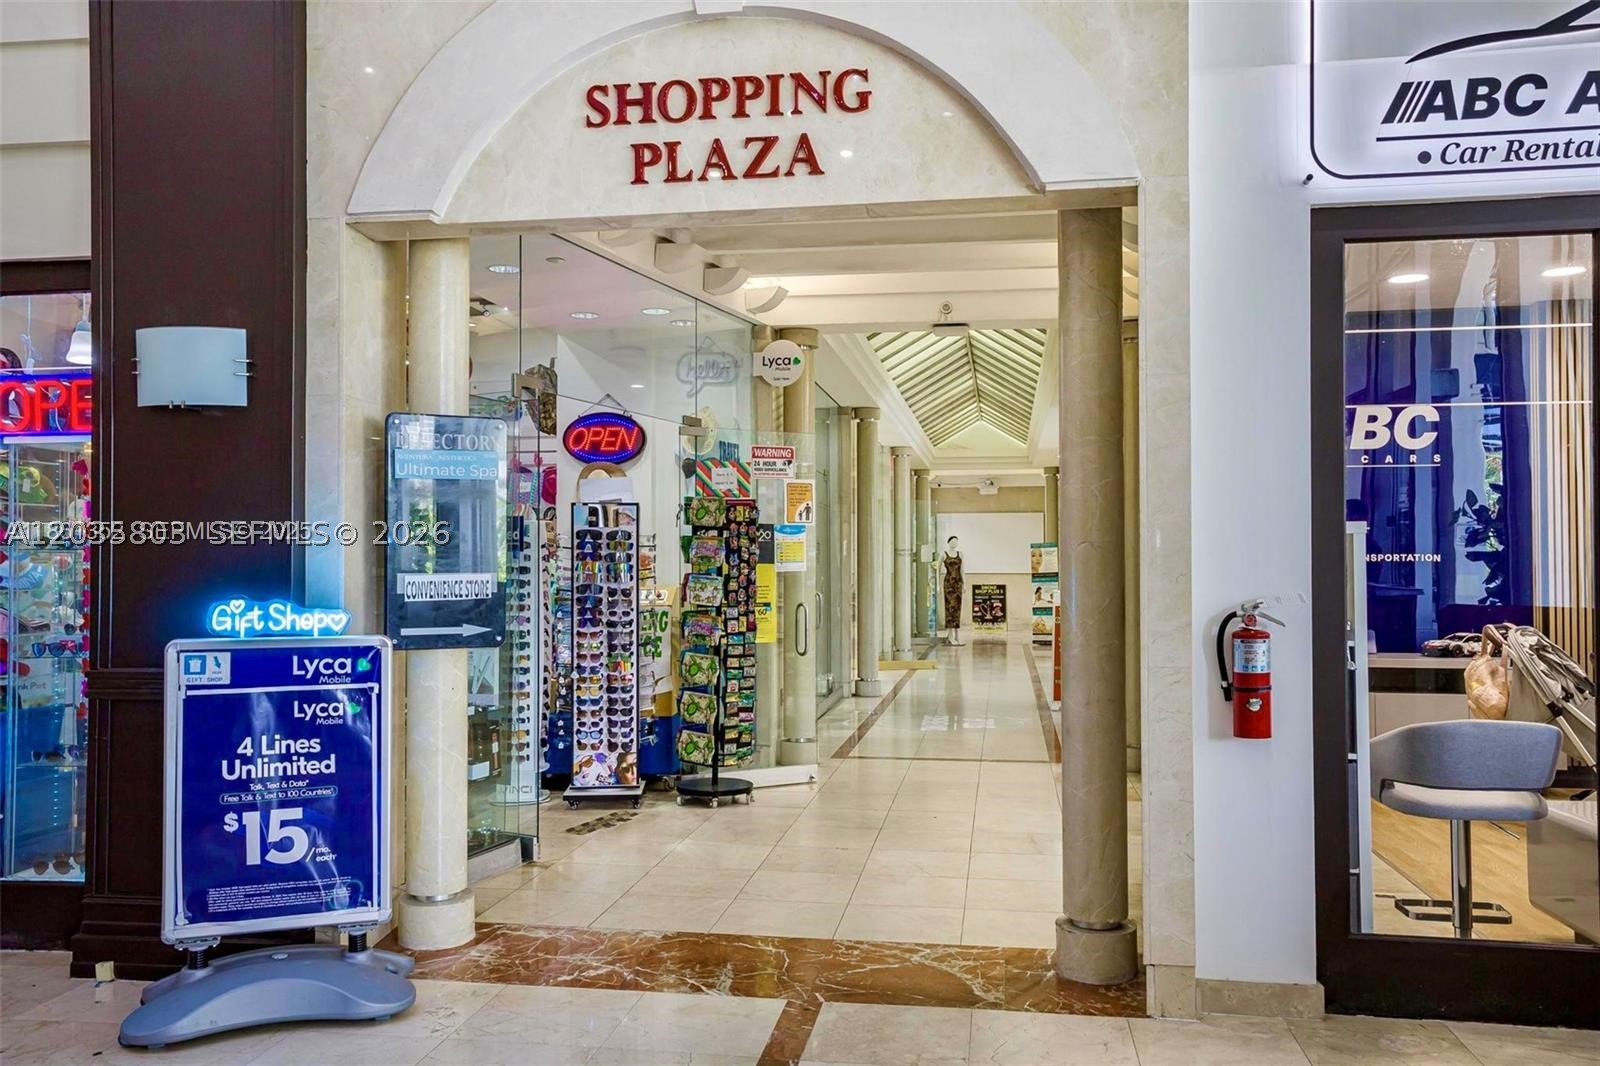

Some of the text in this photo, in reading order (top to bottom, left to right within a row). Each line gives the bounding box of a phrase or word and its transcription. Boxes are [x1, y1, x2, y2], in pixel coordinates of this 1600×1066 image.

[585, 68, 872, 129] SHOPPING
[1381, 73, 1549, 125] ABC
[629, 132, 826, 185] PLAZA
[1439, 141, 1497, 165] Car
[762, 355, 791, 368] Lyca
[569, 426, 639, 451] OPEN
[753, 447, 792, 458] WARNING
[1360, 453, 1441, 464] CARS
[396, 462, 497, 479] Ultimate Spa
[405, 579, 490, 599] CONVENIENCE STORE
[211, 600, 328, 638] Gift Shop
[292, 655, 352, 679] Lyca
[318, 674, 352, 684] Mobile
[293, 700, 344, 721] Lyca
[315, 717, 344, 726] Mobile
[236, 734, 321, 756] 4 Lines
[222, 753, 336, 780] Unlimited
[266, 781, 280, 790] Text
[281, 780, 288, 788] &
[223, 795, 240, 803] Free
[241, 794, 254, 802] Talk
[255, 793, 262, 801] &
[263, 791, 277, 799] Text
[287, 789, 300, 798] 100
